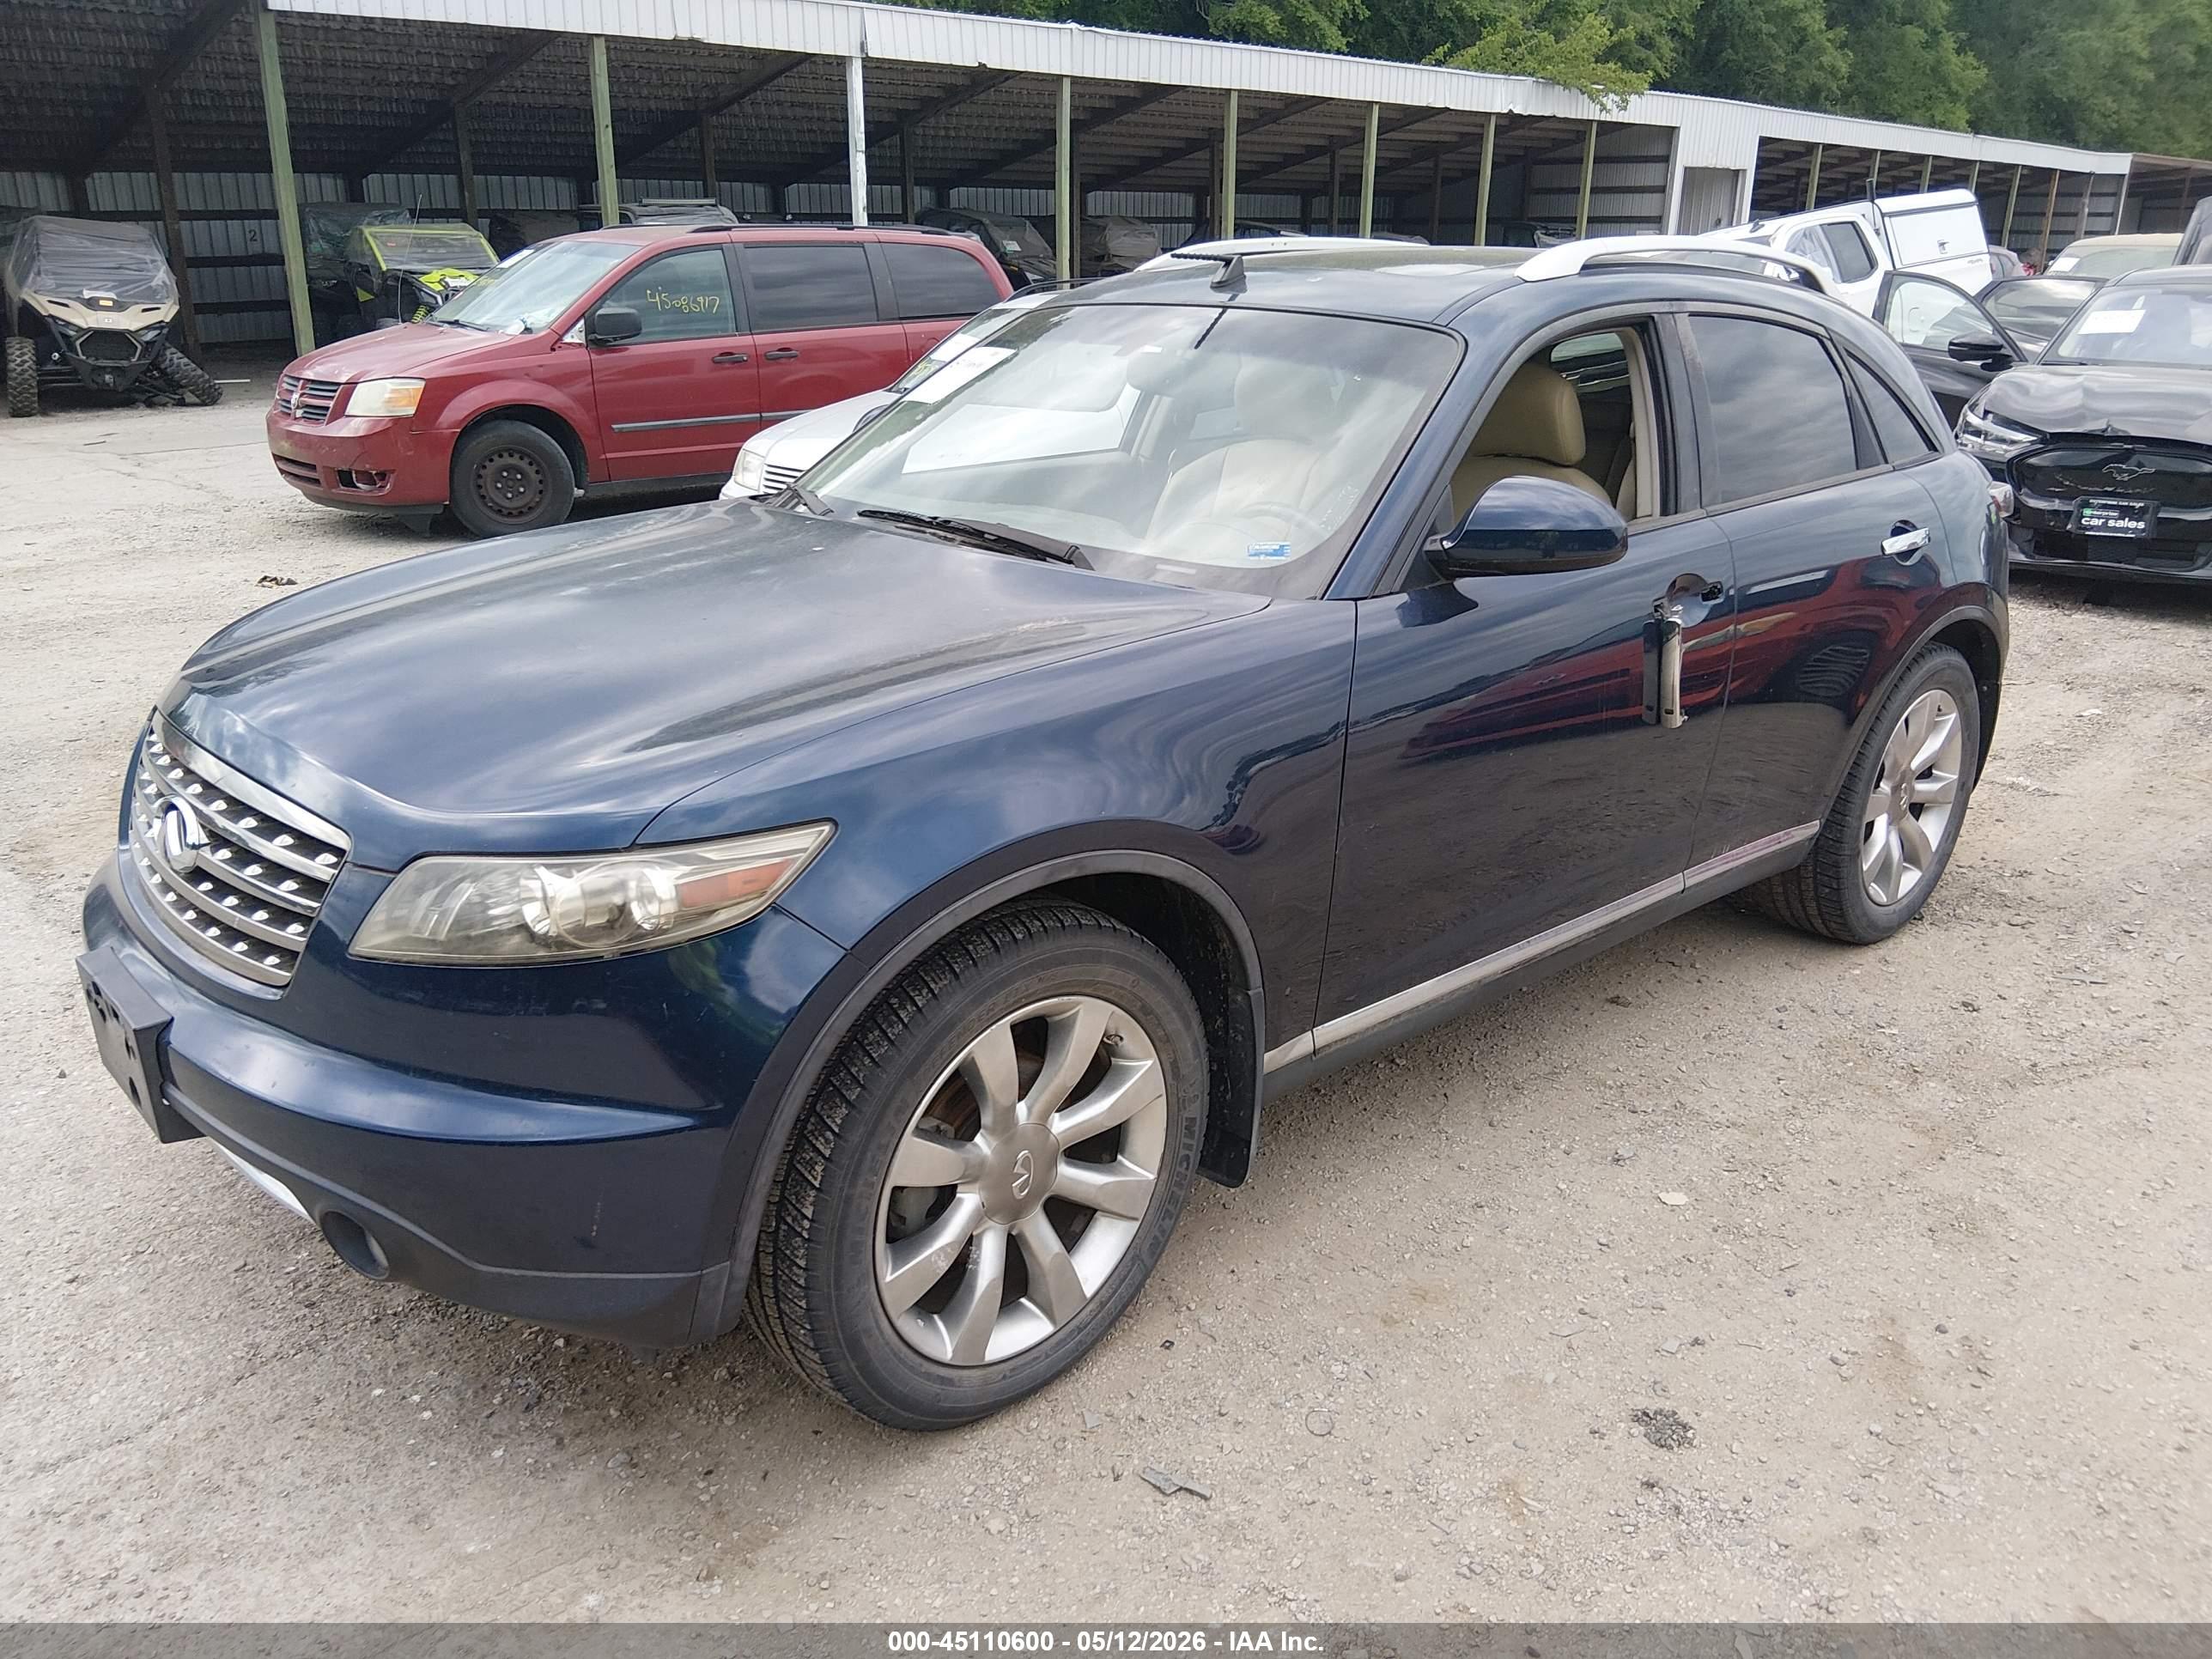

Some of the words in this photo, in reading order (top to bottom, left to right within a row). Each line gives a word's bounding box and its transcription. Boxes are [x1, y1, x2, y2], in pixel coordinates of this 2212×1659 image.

[249, 229, 258, 241] 2
[2081, 517, 2106, 526] car
[2107, 517, 2146, 529] sales
[1147, 1116, 1198, 1259] MICHELIN
